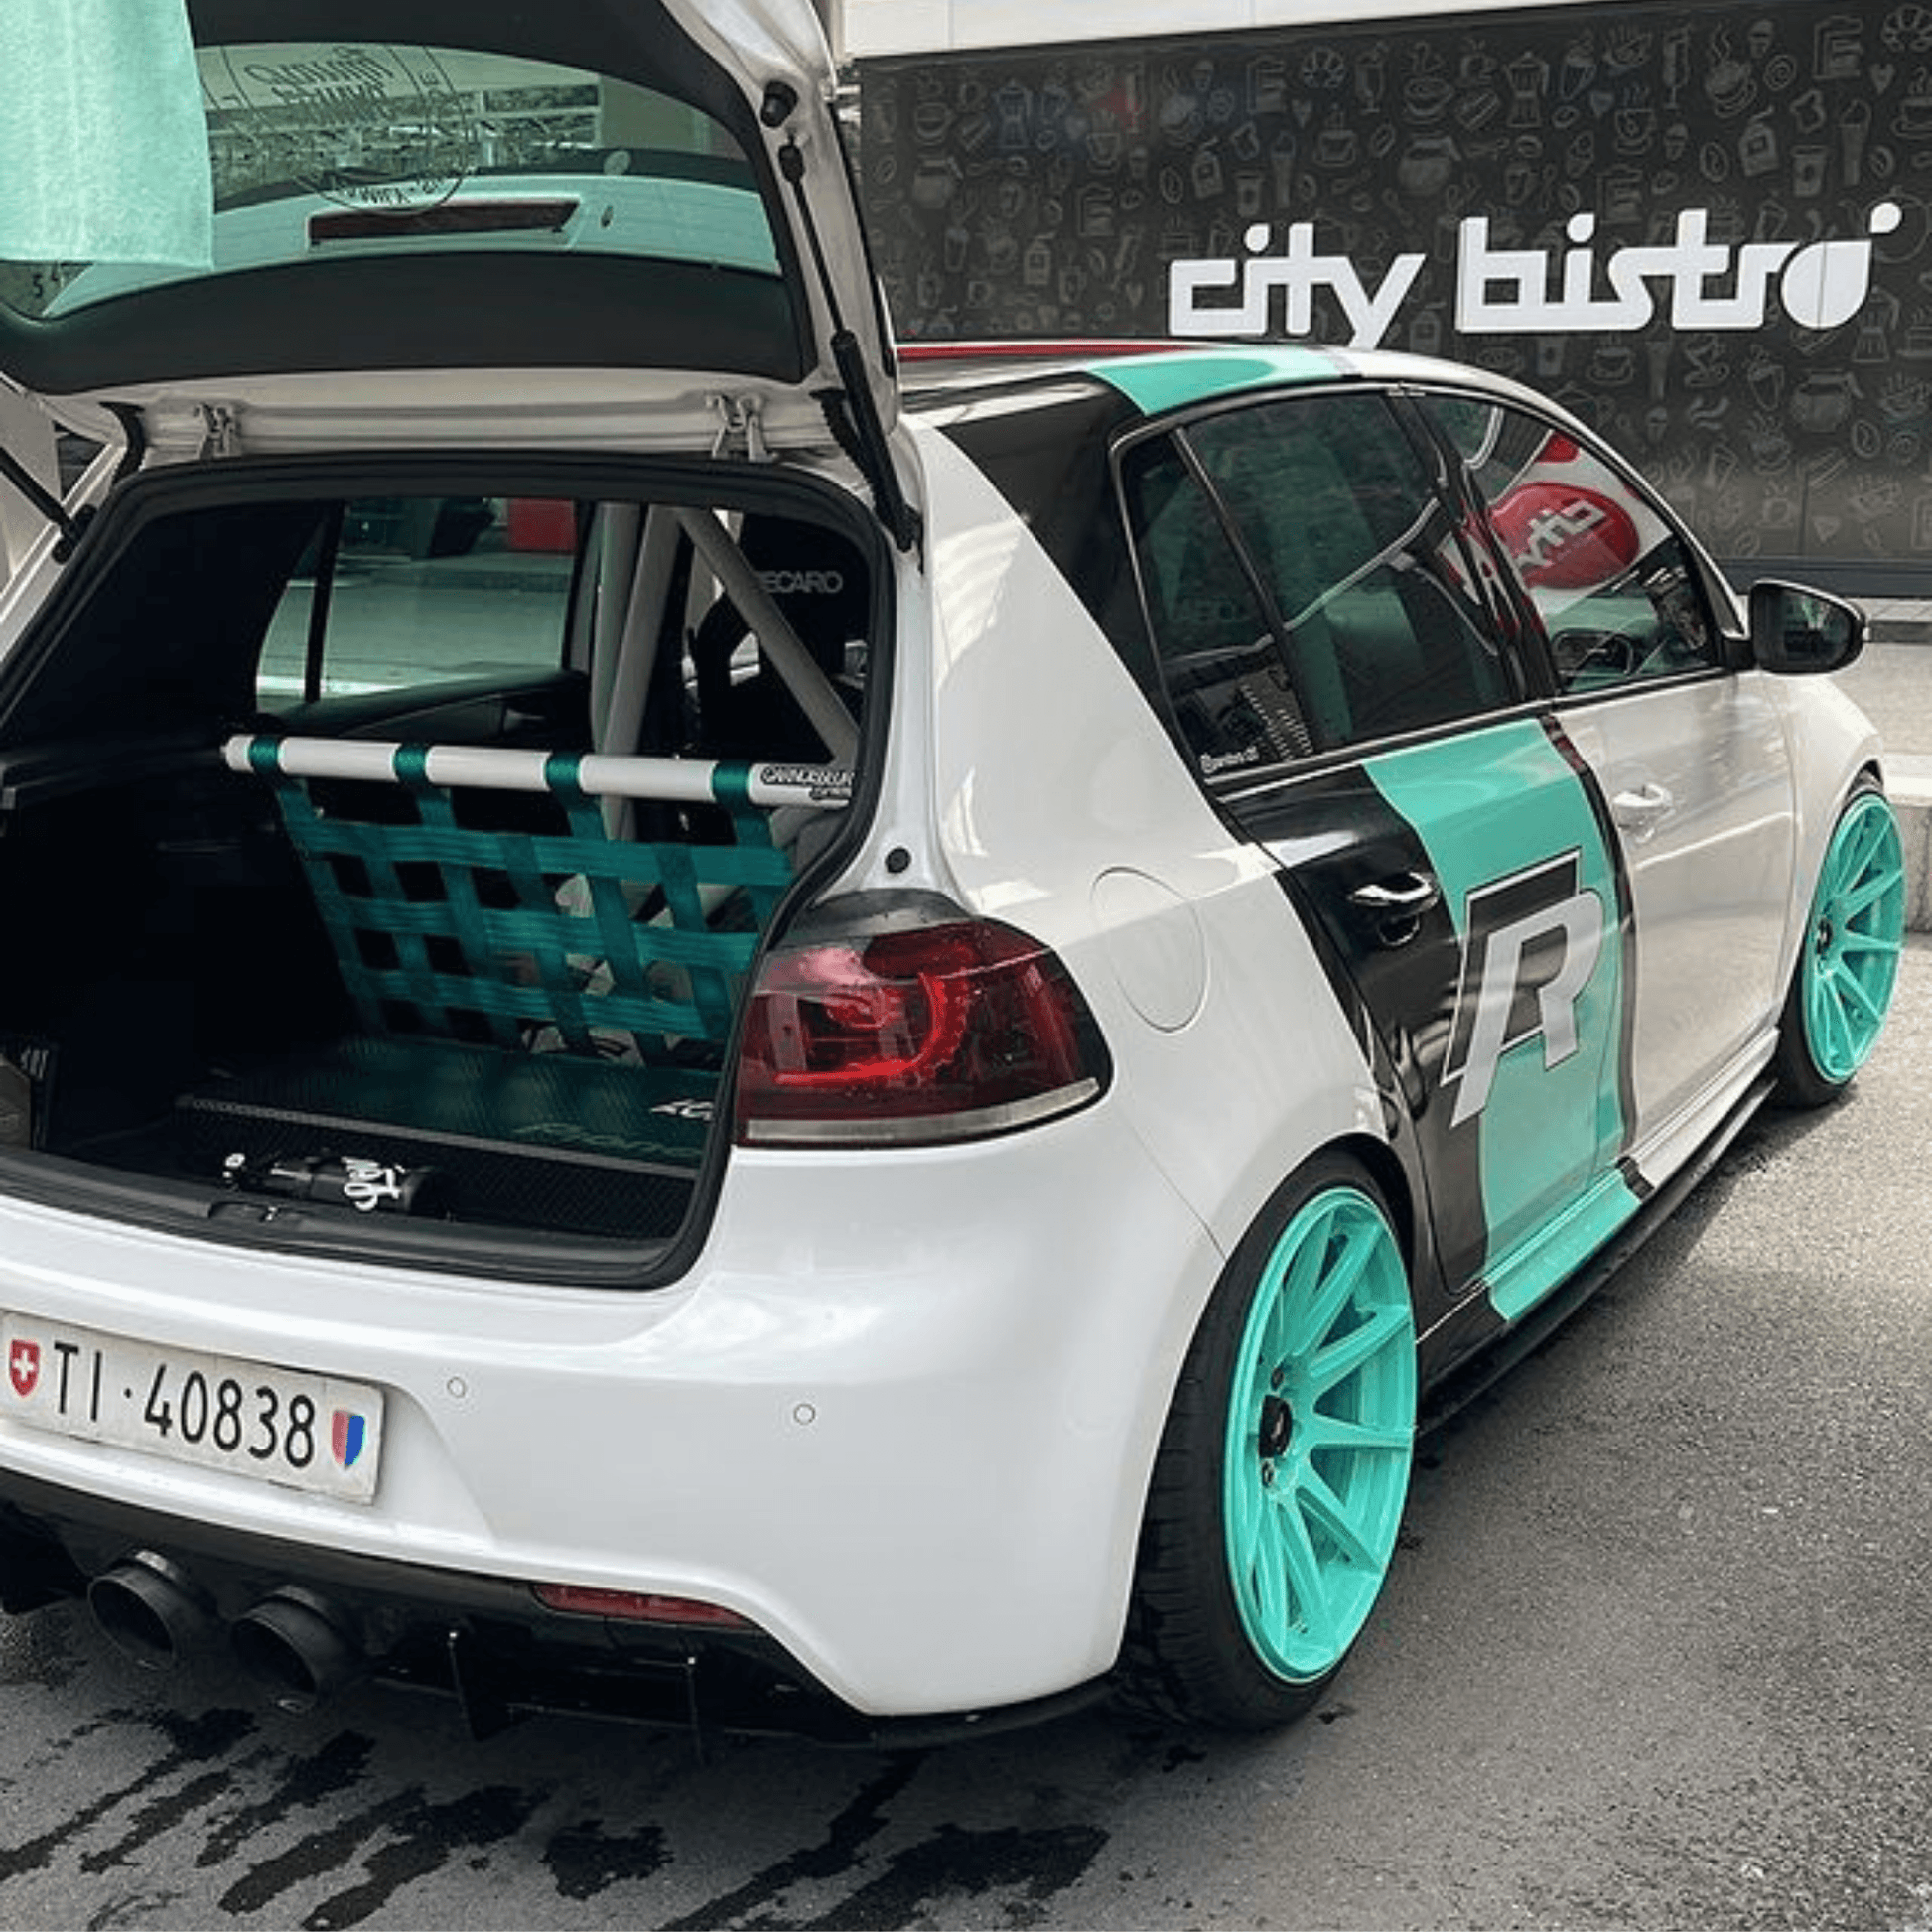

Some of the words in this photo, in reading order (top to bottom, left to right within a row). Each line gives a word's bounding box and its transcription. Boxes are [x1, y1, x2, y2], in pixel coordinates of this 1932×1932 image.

[1169, 223, 1427, 351] city
[757, 570, 844, 594] ECARO
[1449, 889, 1604, 1129] R
[144, 1363, 316, 1469] 40838
